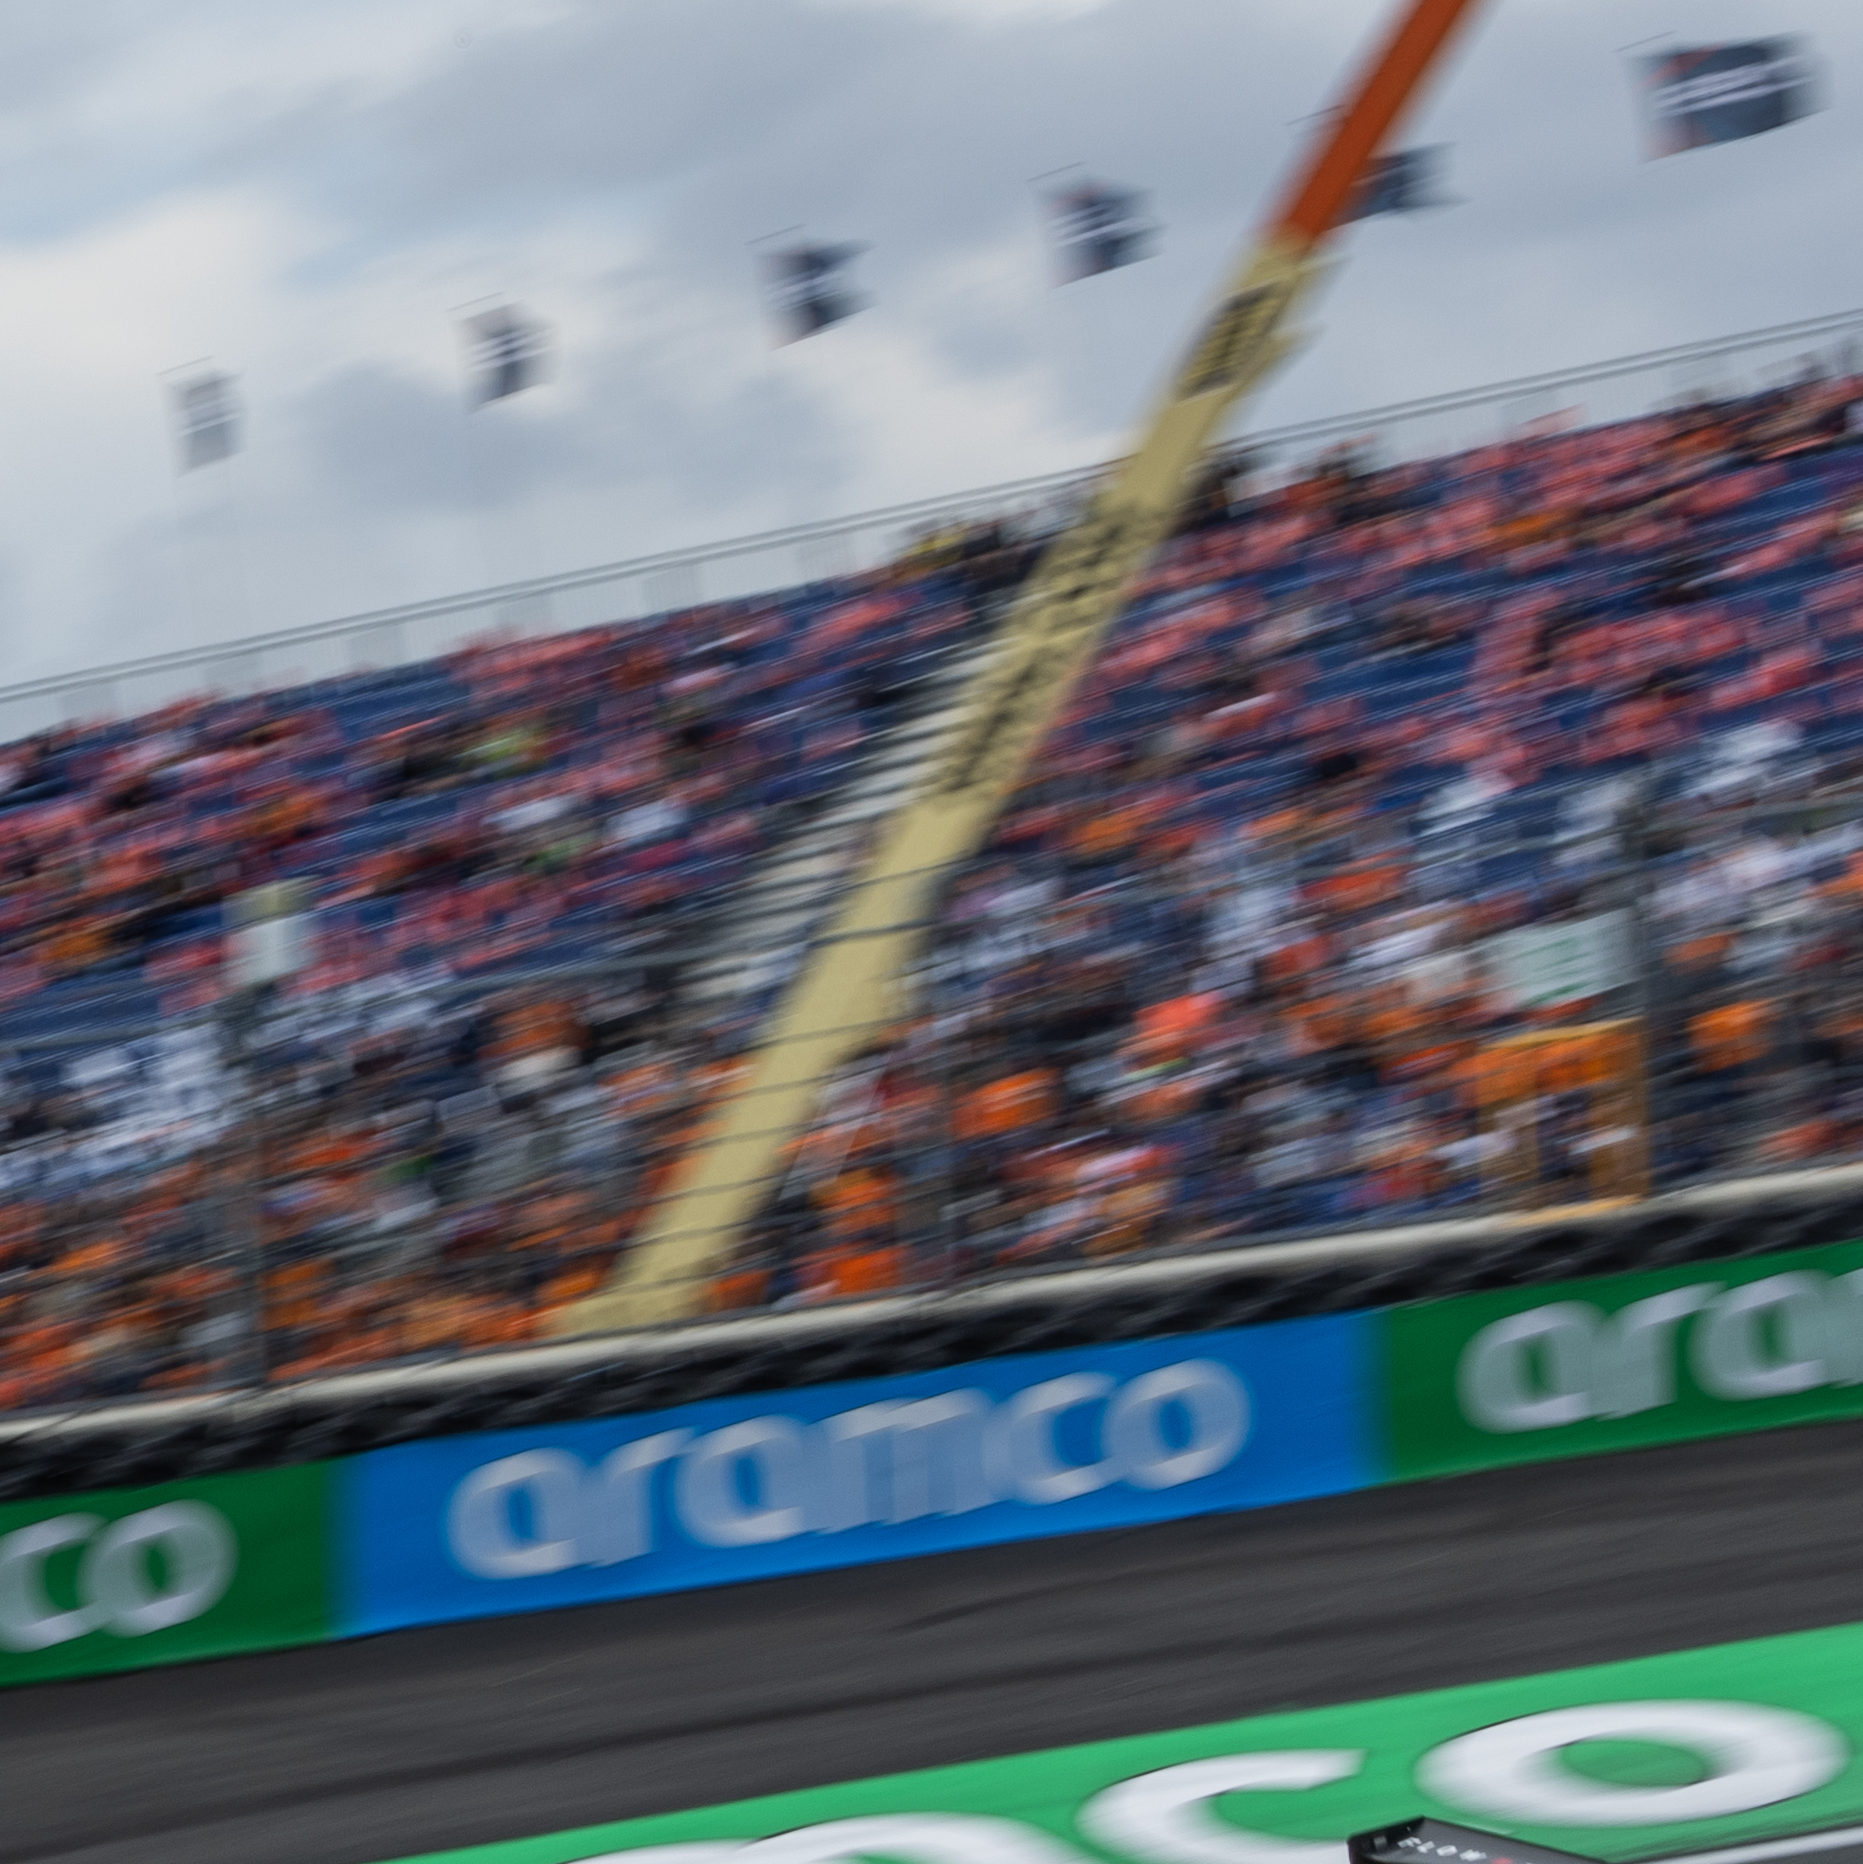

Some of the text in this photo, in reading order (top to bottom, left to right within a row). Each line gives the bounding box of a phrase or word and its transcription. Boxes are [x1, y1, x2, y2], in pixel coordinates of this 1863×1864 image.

[1456, 1264, 1863, 1436] ara
[446, 1359, 1254, 1582] aramco
[1398, 1837, 1488, 1863] FLOW
